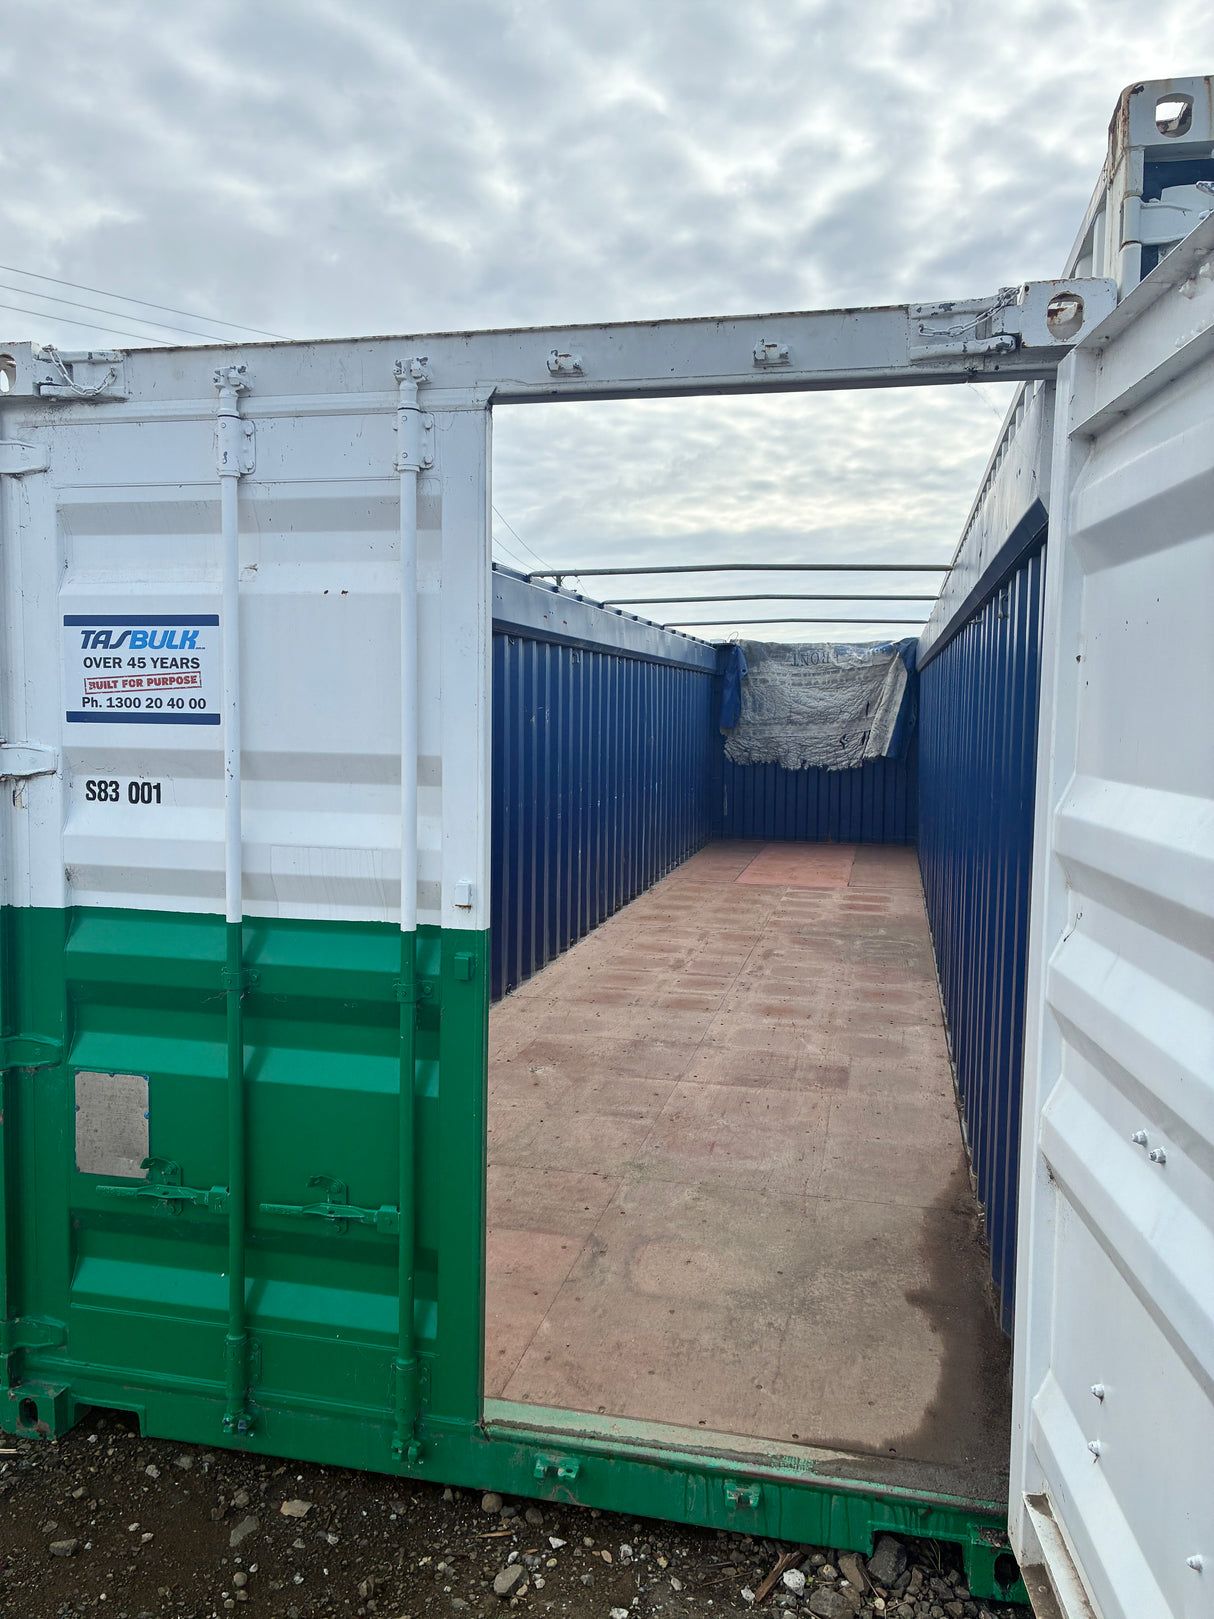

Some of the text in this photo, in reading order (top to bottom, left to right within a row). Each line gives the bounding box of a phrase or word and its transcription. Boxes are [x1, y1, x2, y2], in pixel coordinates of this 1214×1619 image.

[83, 657, 200, 669] OVER 45 YEARS
[88, 675, 197, 690] BUILT FOR PURPOSE
[82, 697, 206, 709] Ph. 1300 20 40 00
[85, 780, 162, 804] S83 001
